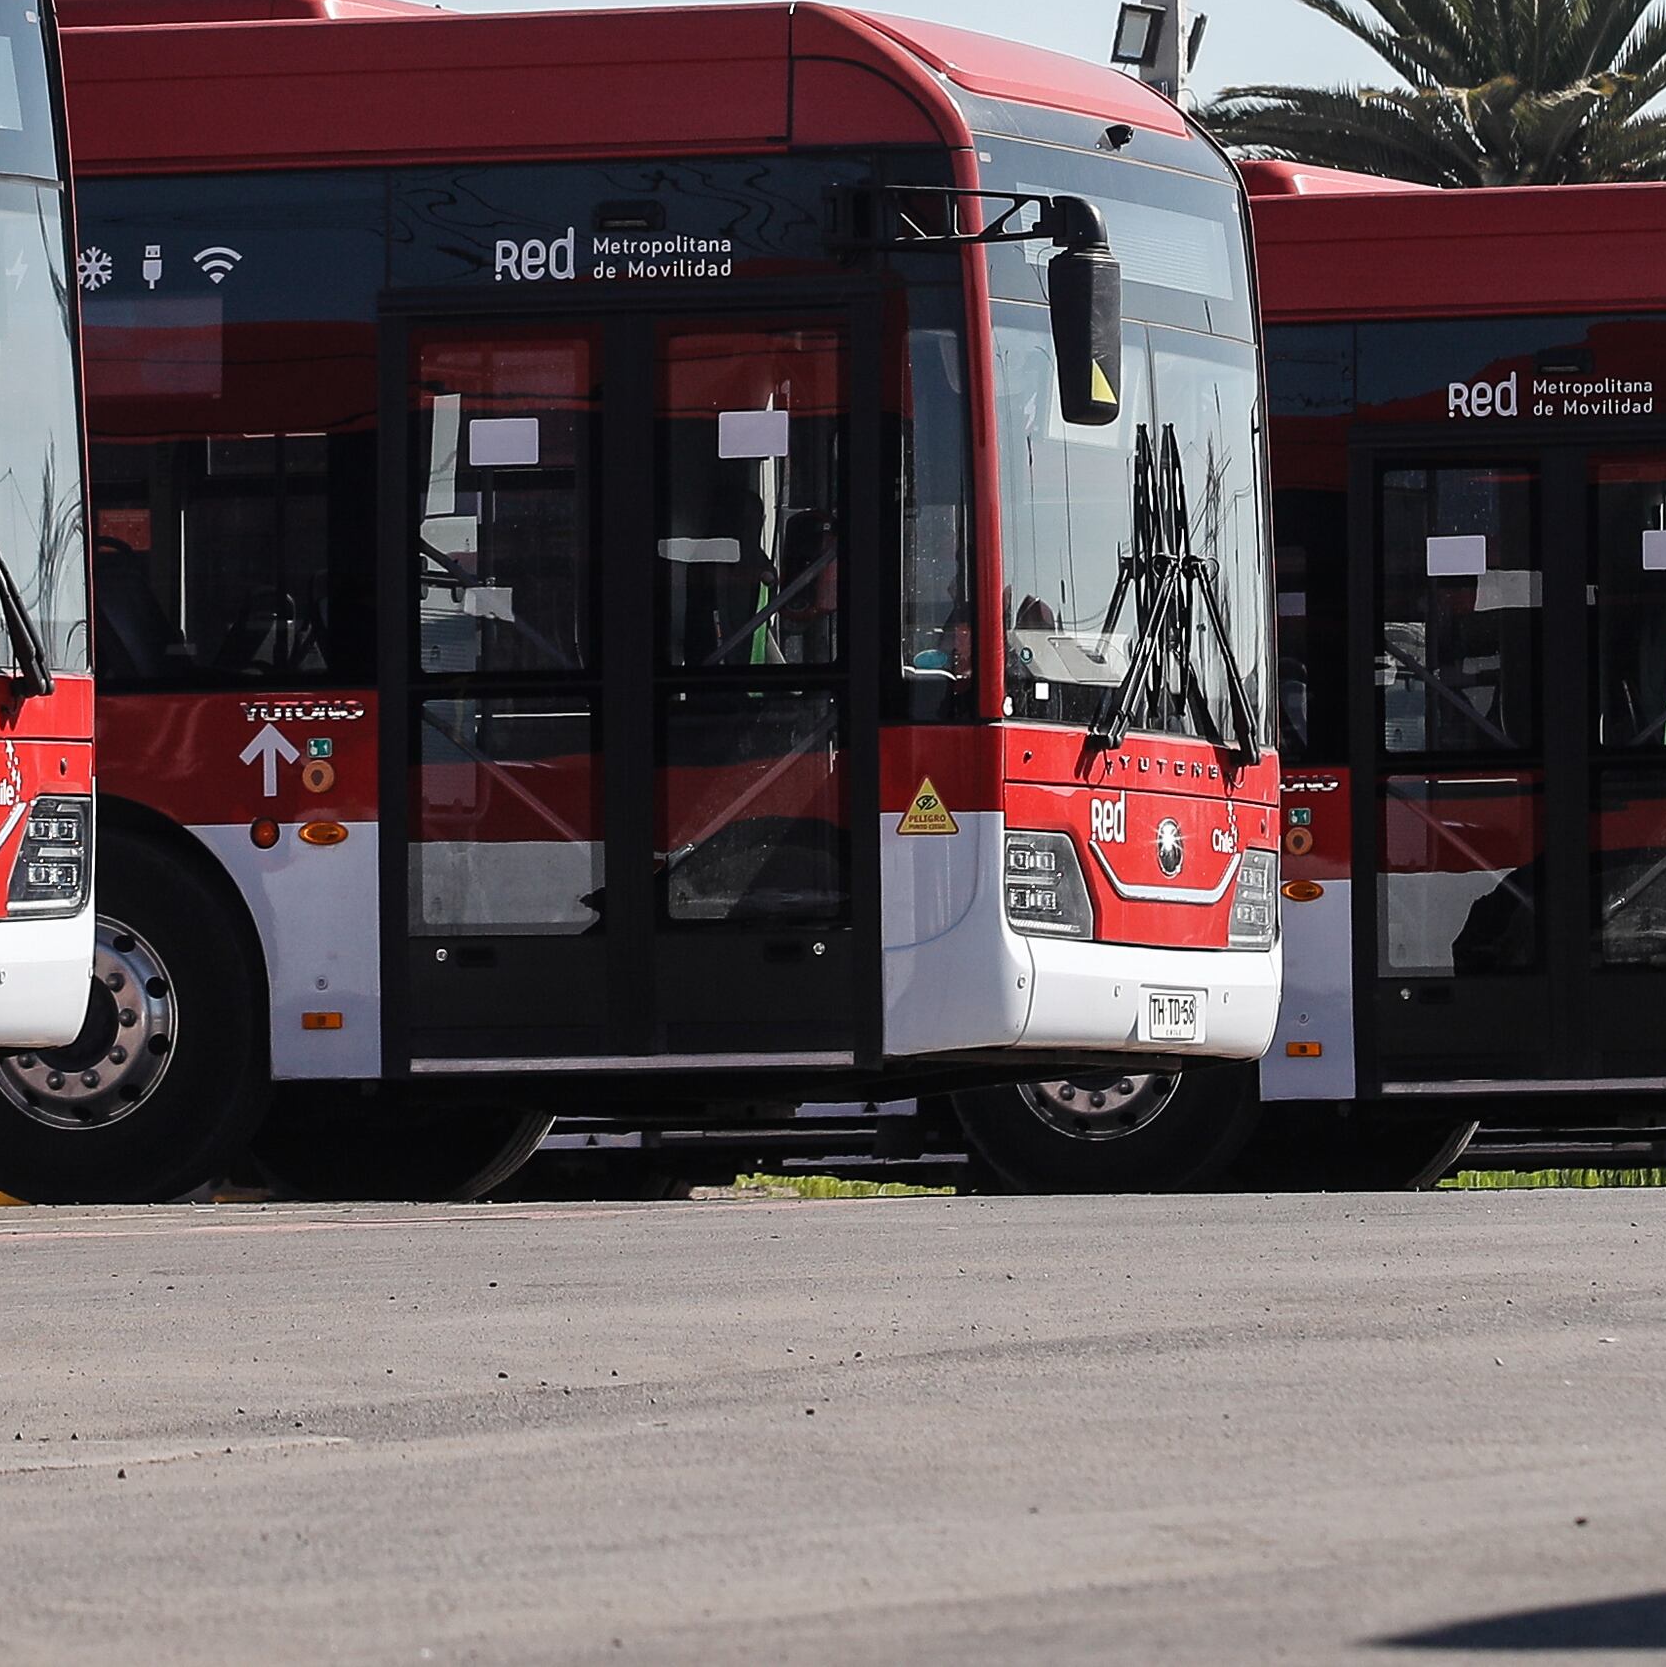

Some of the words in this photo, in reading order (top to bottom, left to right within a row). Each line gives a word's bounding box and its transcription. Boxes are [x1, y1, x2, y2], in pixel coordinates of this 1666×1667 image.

[494, 226, 575, 281] Red
[593, 235, 732, 257] Metropolitana
[593, 261, 617, 279] de
[628, 258, 732, 278] Movilidad
[1448, 371, 1518, 418] Red
[1533, 378, 1653, 397] Metropolitana
[1533, 399, 1554, 416] de
[1563, 397, 1653, 415] Movilidad
[908, 814, 946, 823] PELIGRO
[1090, 790, 1127, 844] Red
